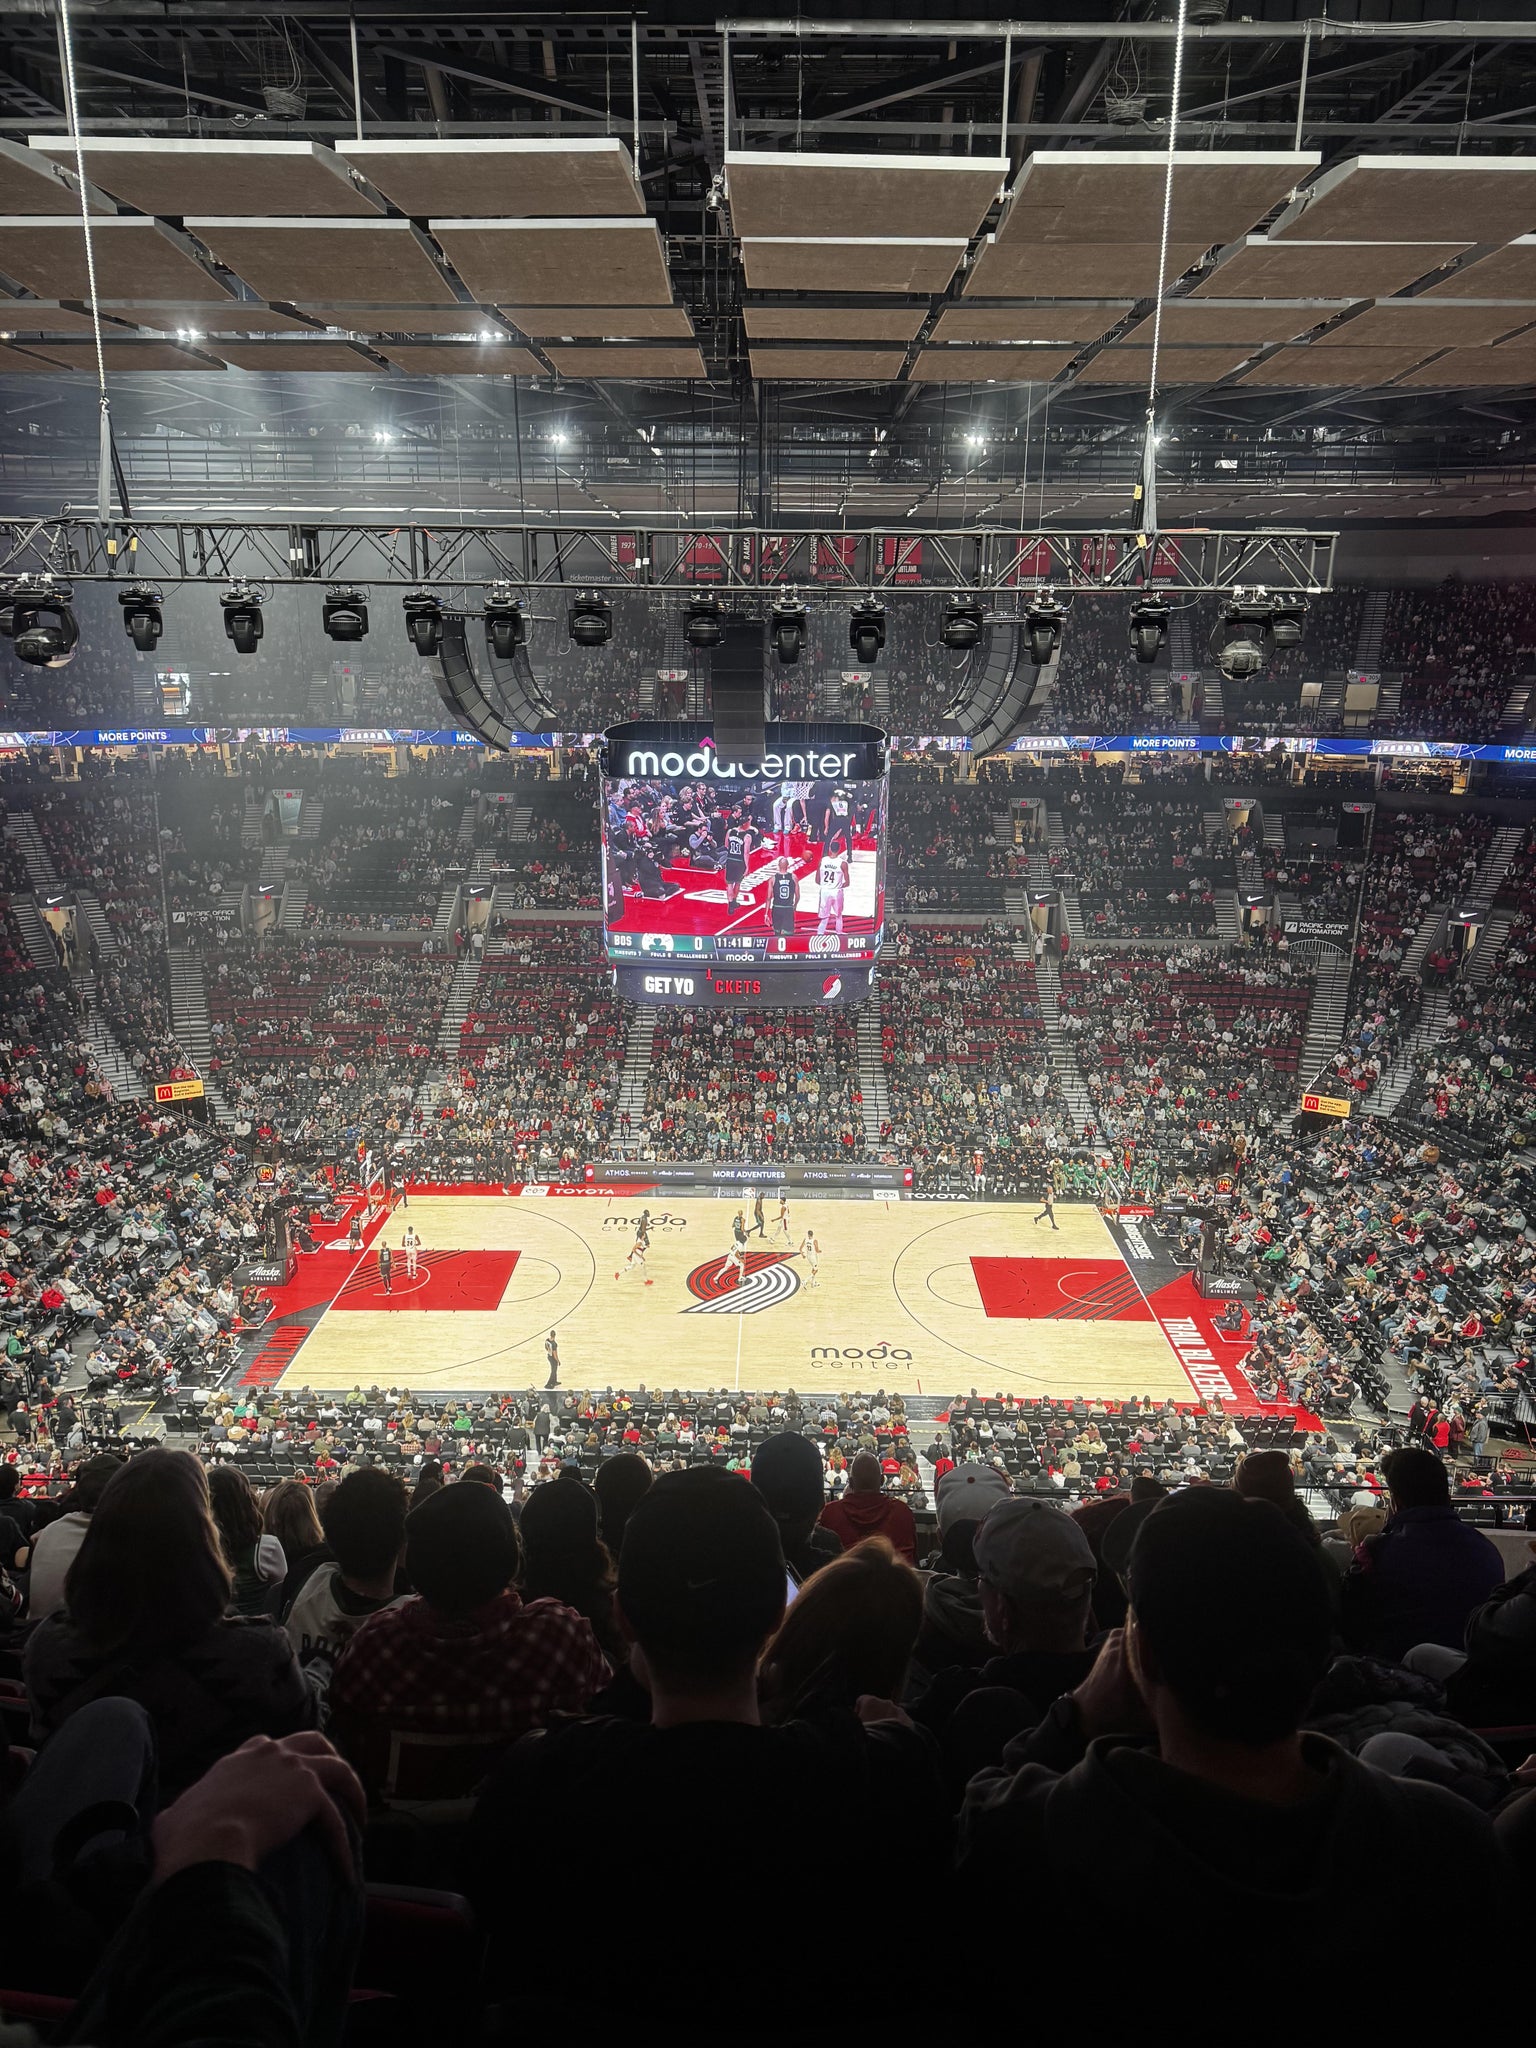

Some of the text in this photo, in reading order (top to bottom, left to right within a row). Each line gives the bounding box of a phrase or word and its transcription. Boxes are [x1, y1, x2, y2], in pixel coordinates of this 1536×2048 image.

[99, 731, 167, 742] MORE POINTS
[1133, 739, 1196, 747] MORE POINTS
[1505, 749, 1536, 759] MORE
[824, 871, 835, 883] 24
[779, 886, 790, 899] 9
[1298, 928, 1343, 936] AUTOMATION
[614, 935, 632, 946] BOS
[694, 937, 703, 950] 0
[717, 938, 741, 948] 11:41
[777, 938, 786, 951] 0
[847, 938, 865, 949] POR
[726, 952, 754, 962] moda
[645, 976, 694, 996] GET YO
[715, 980, 761, 994] CKETS
[712, 1170, 786, 1179] MORE ADVENTURES
[905, 1192, 970, 1200] TOYOTA
[1161, 1316, 1207, 1347] TRAIL
[811, 1345, 913, 1361] moda
[811, 1360, 914, 1370] center
[1177, 1348, 1238, 1401] BLAZERS
